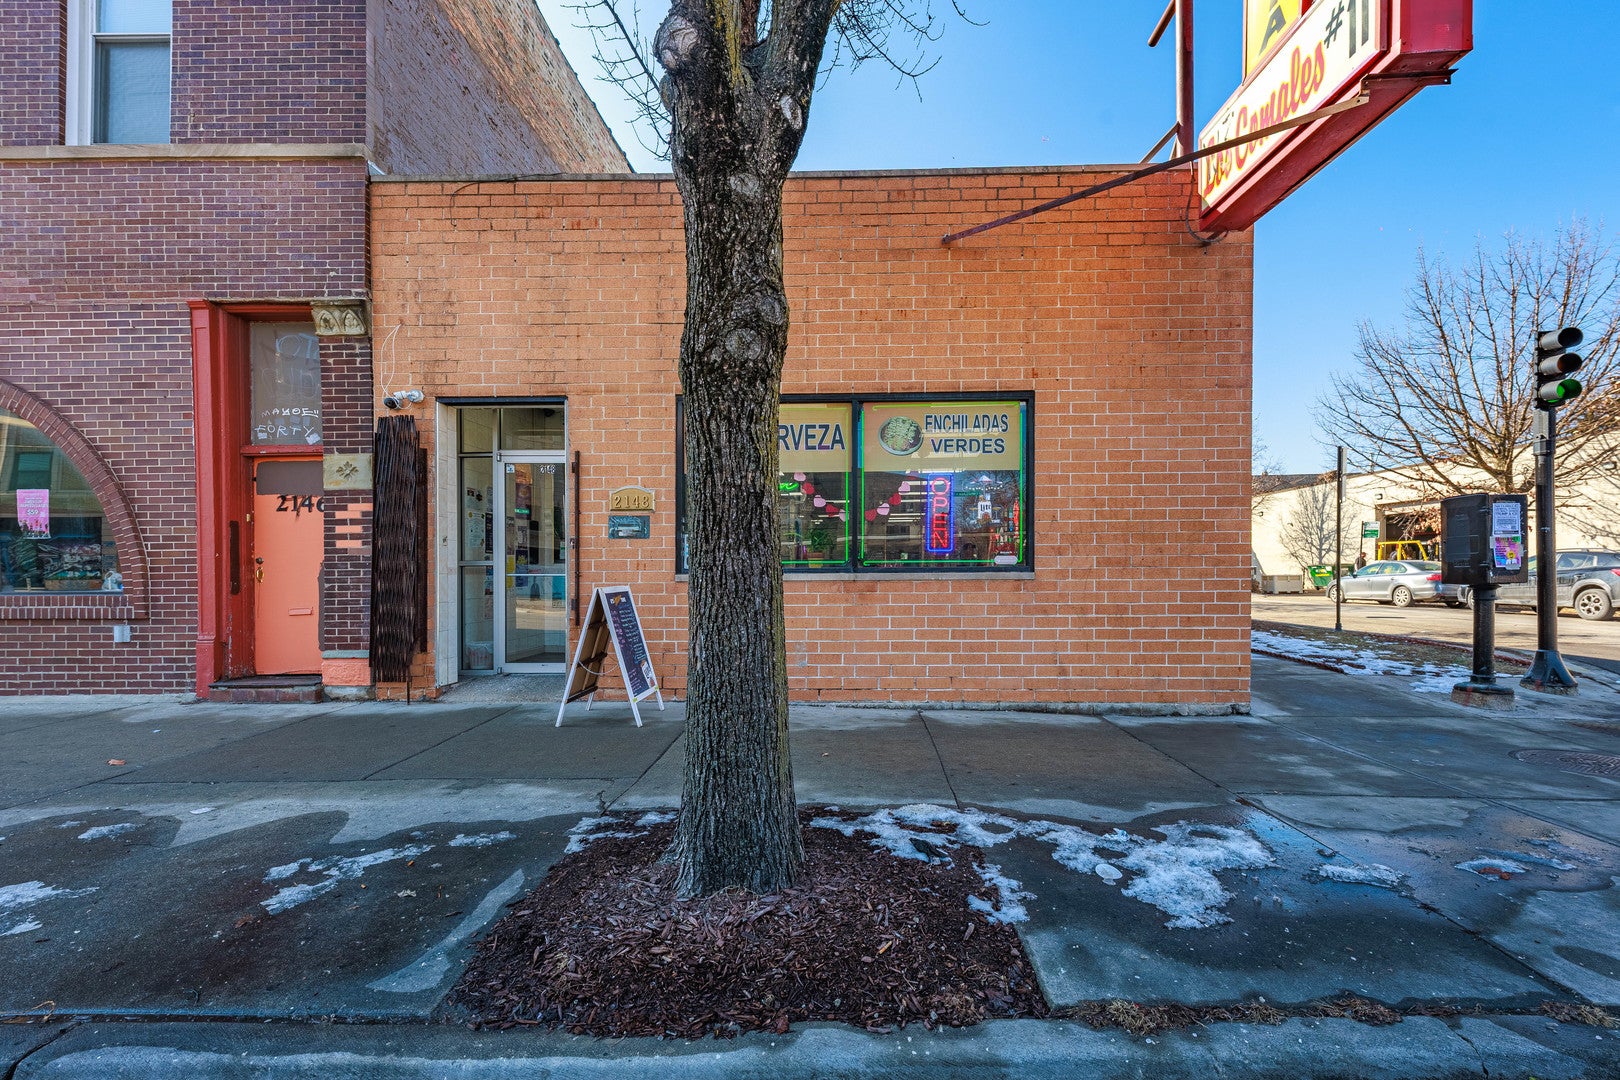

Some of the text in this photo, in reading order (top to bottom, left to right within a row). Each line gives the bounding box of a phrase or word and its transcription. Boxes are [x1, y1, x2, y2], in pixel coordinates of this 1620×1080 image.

[1234, 40, 1325, 171] Comales
[925, 414, 1009, 433] ENCHILADAS
[778, 423, 846, 451] RVEZA
[930, 438, 1006, 454] VERDES
[614, 495, 650, 509] 2148
[931, 477, 950, 549] OPEN
